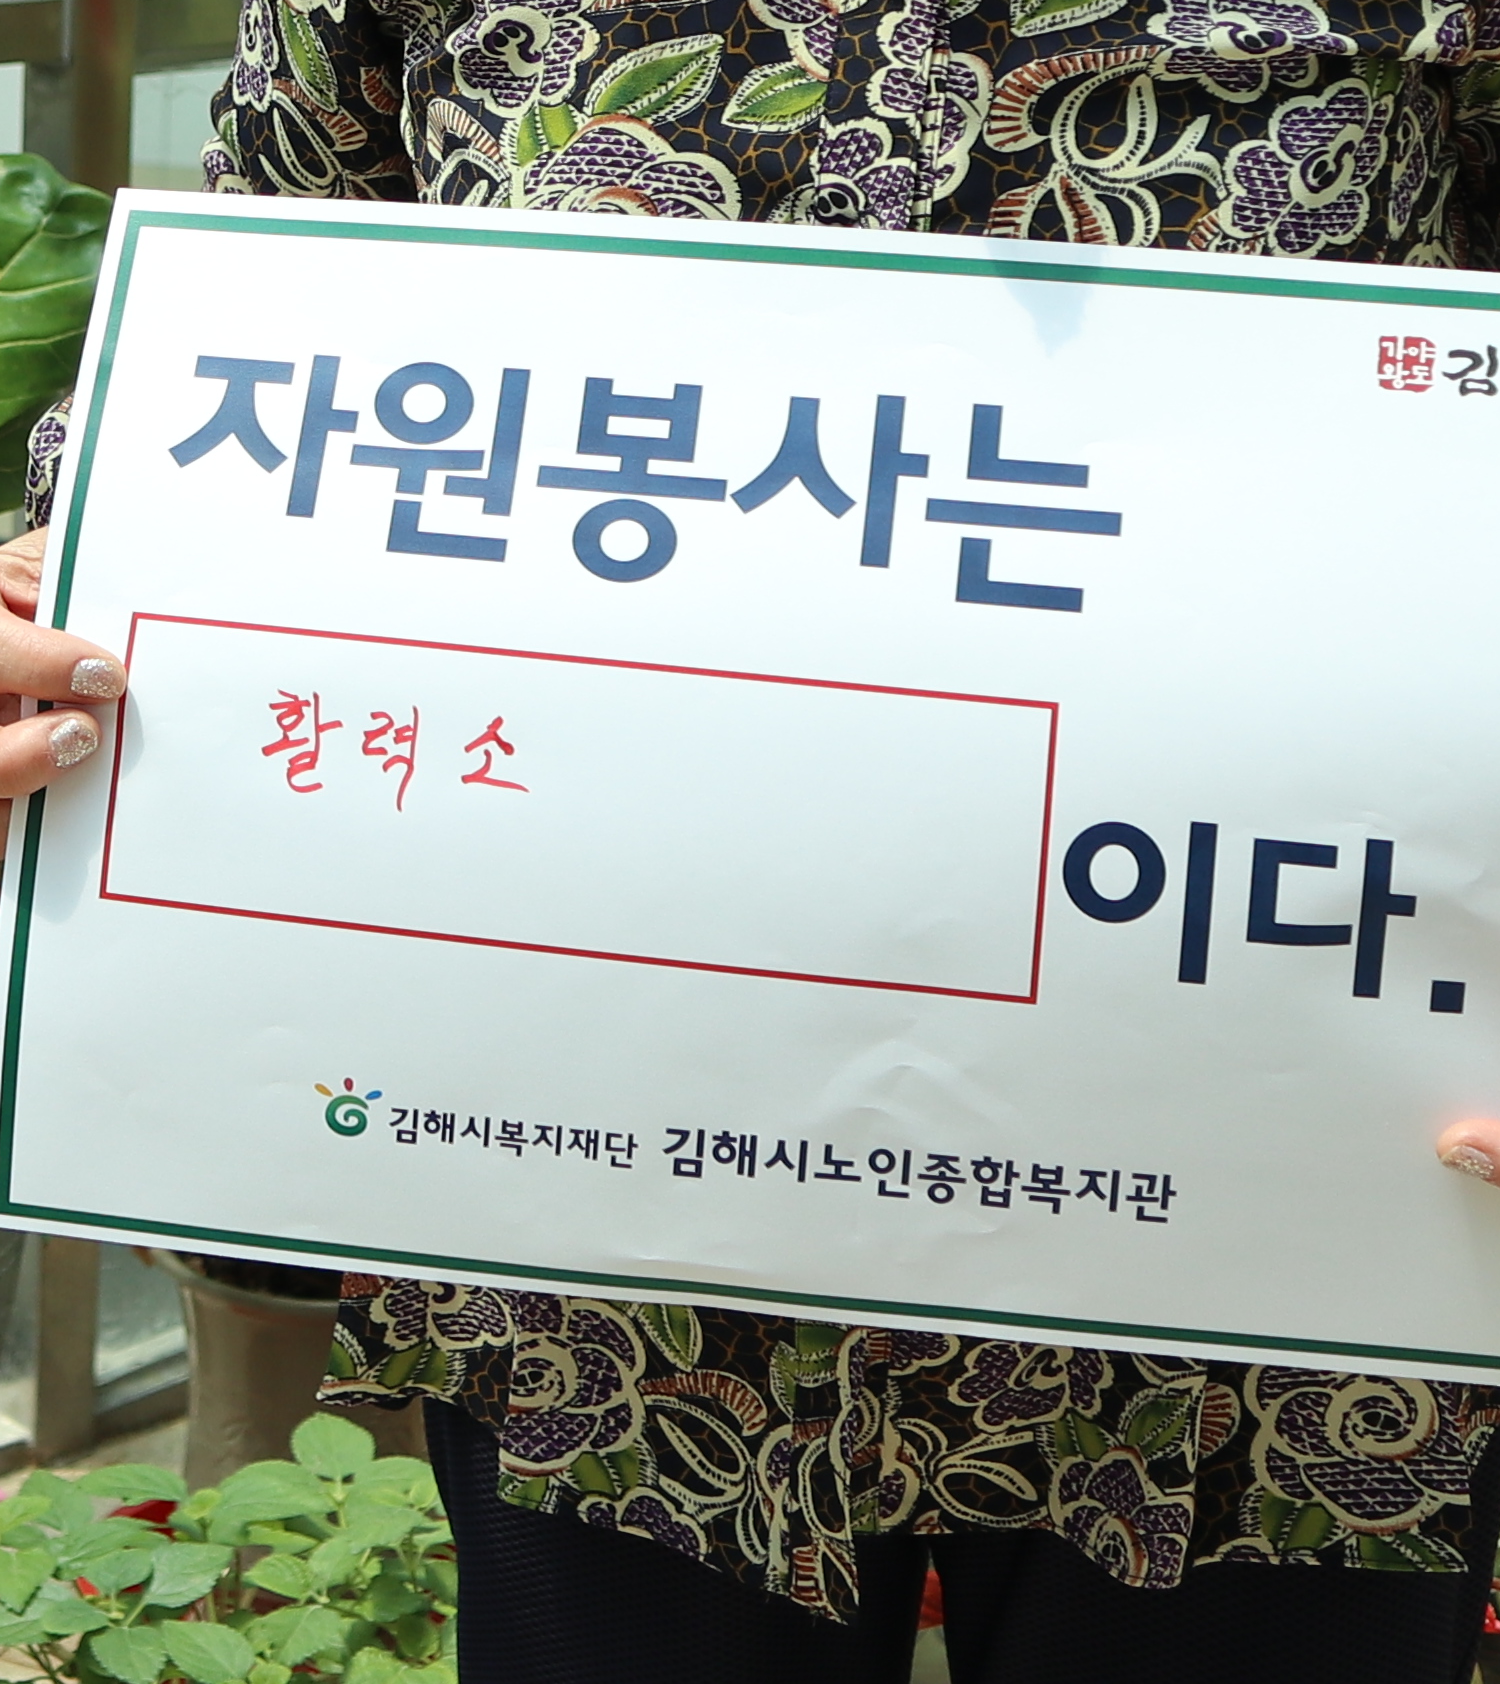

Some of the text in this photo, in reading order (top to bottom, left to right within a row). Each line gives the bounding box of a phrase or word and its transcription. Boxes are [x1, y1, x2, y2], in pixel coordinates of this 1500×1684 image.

[170, 353, 1123, 614] 자원봉사는
[1062, 820, 1468, 1016] 이다.
[389, 1107, 1178, 1224] 김해시복지재단 김해시노인종합복지관
